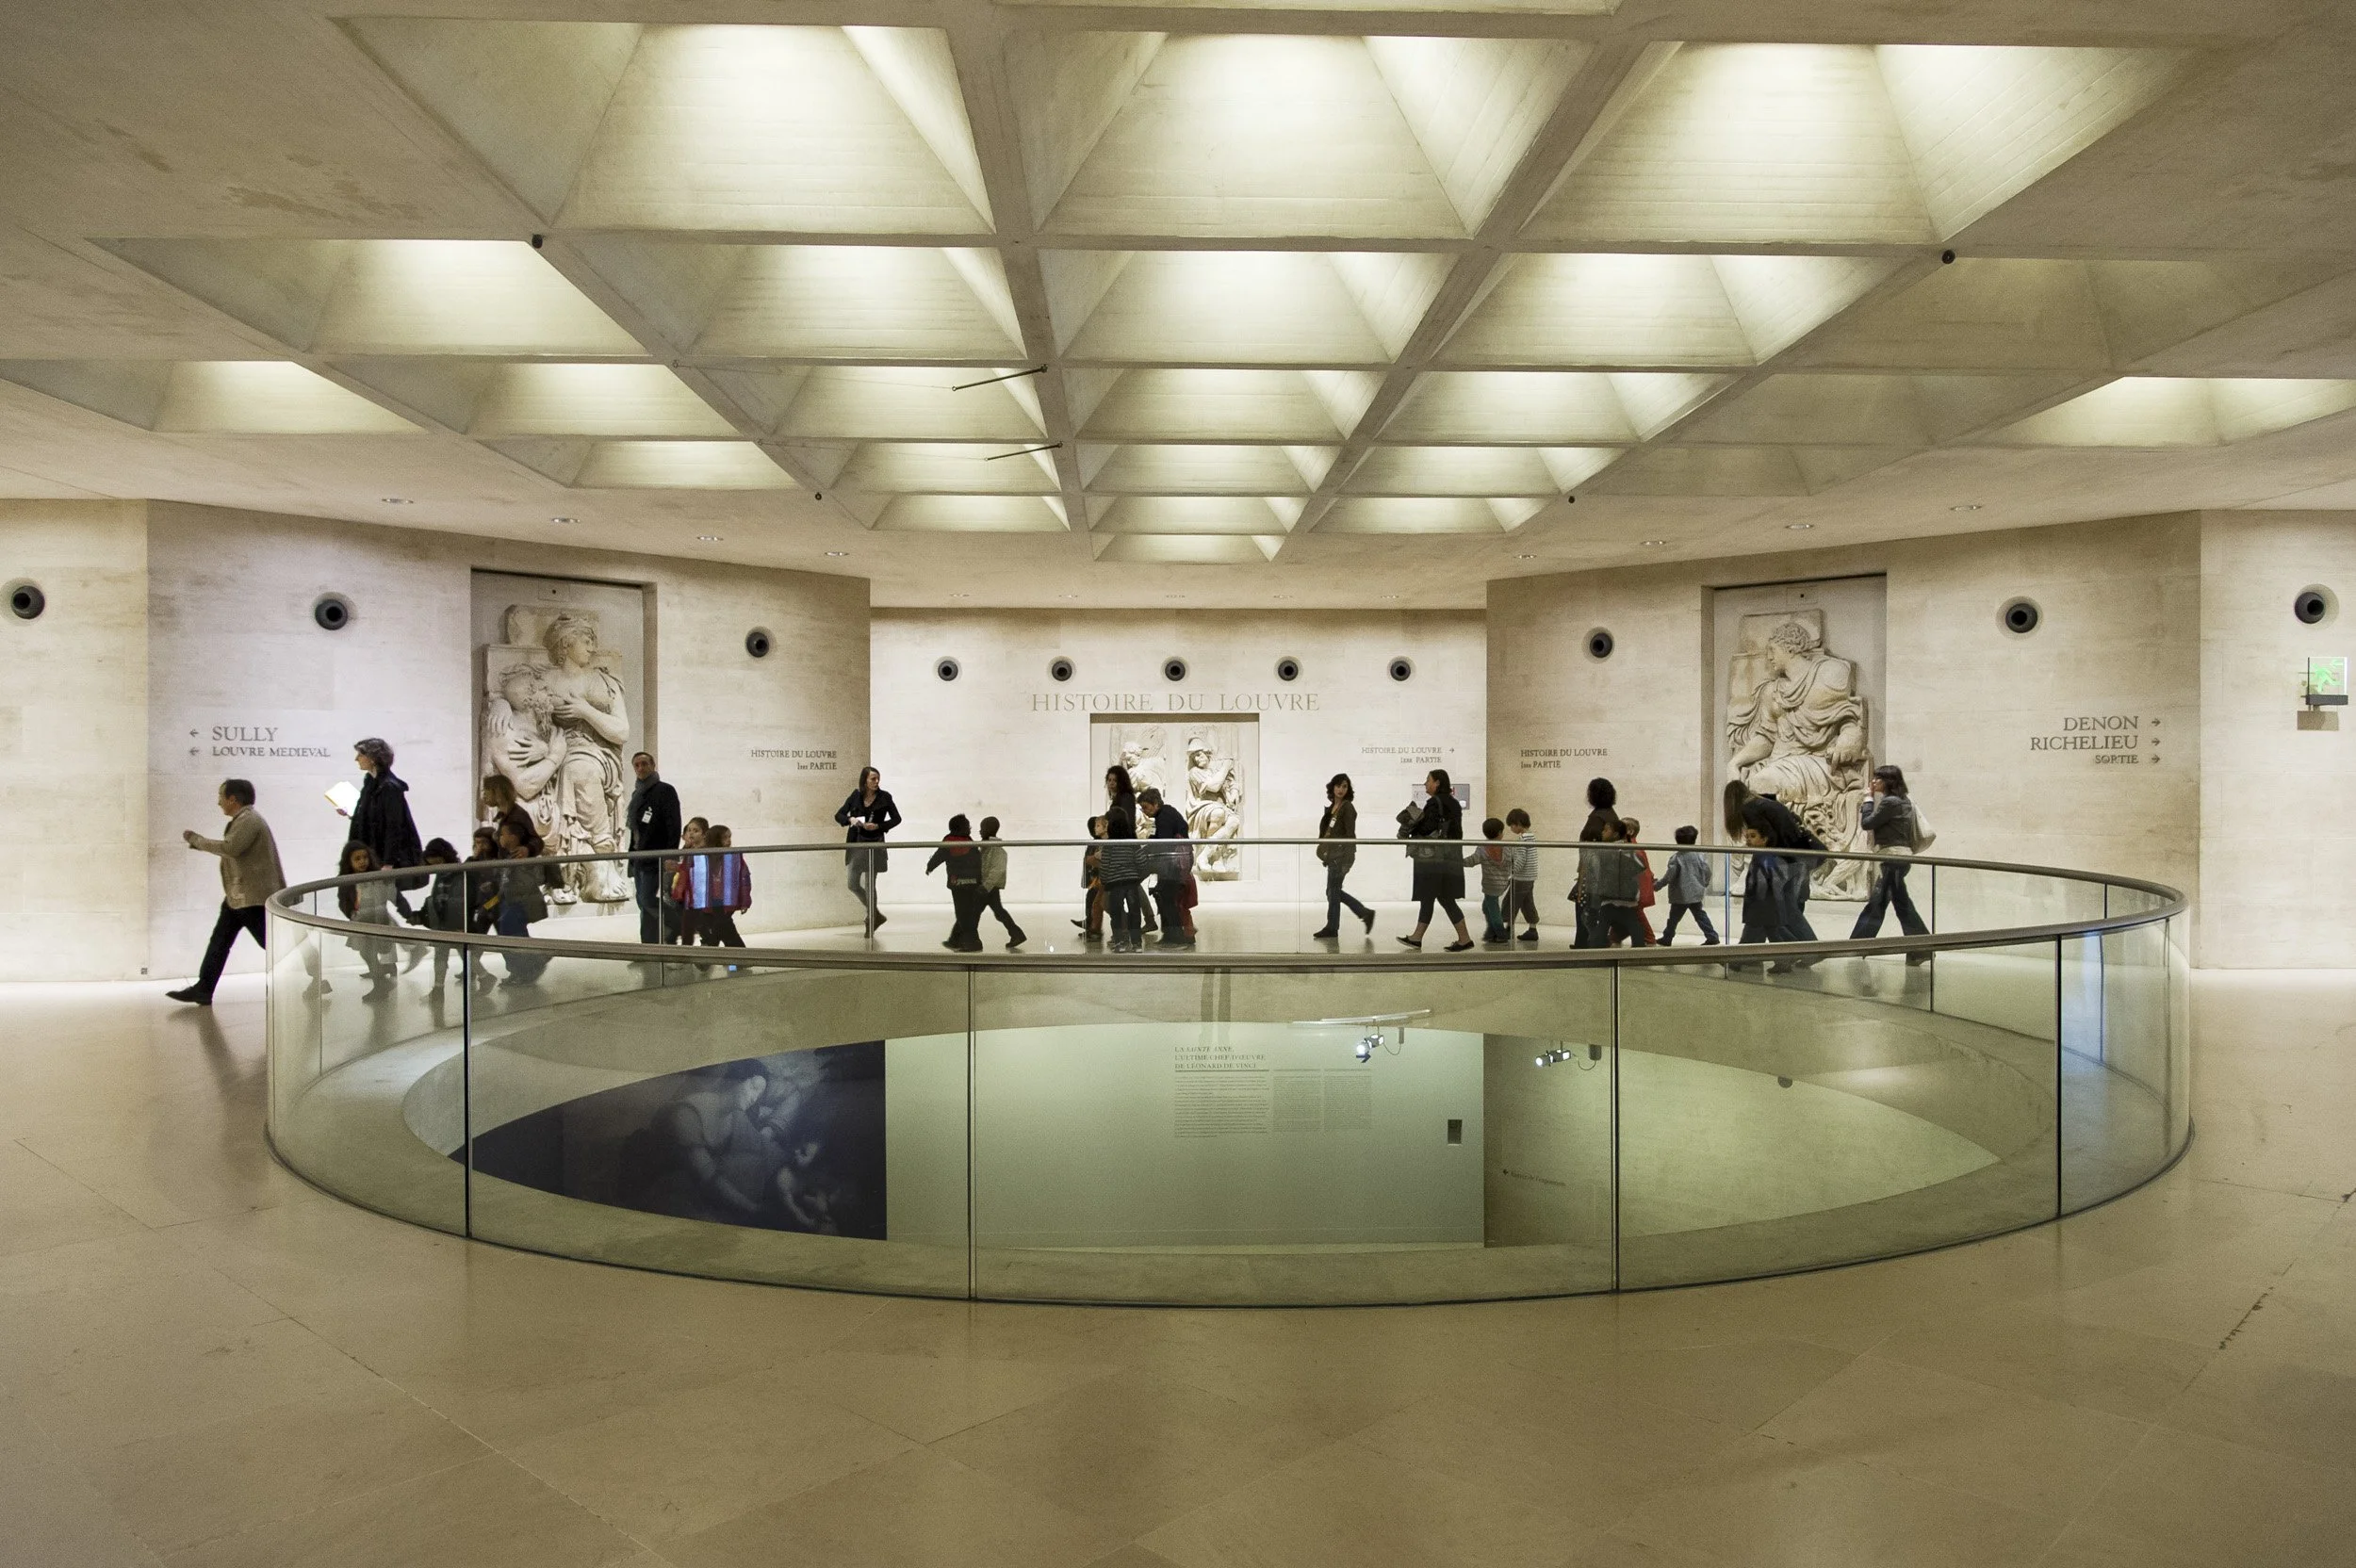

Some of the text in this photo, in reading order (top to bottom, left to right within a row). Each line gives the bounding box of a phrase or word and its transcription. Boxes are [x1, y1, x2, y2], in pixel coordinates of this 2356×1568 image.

[1032, 693, 1320, 711] HISTOIRE DU LOUVRE
[2063, 715, 2139, 731] DENON
[211, 726, 279, 742] SULLY
[2030, 735, 2138, 751] RICHELIEU
[211, 745, 331, 758] LOUVRE MEDIEVAL
[750, 749, 837, 760] HISTOIRE DU LOUVRE
[1520, 748, 1608, 758] HISTOIRE DU LOUVRE
[810, 761, 838, 770] PARTIE
[1532, 760, 1562, 769] PARTIE
[2095, 755, 2139, 764] SORTIE
